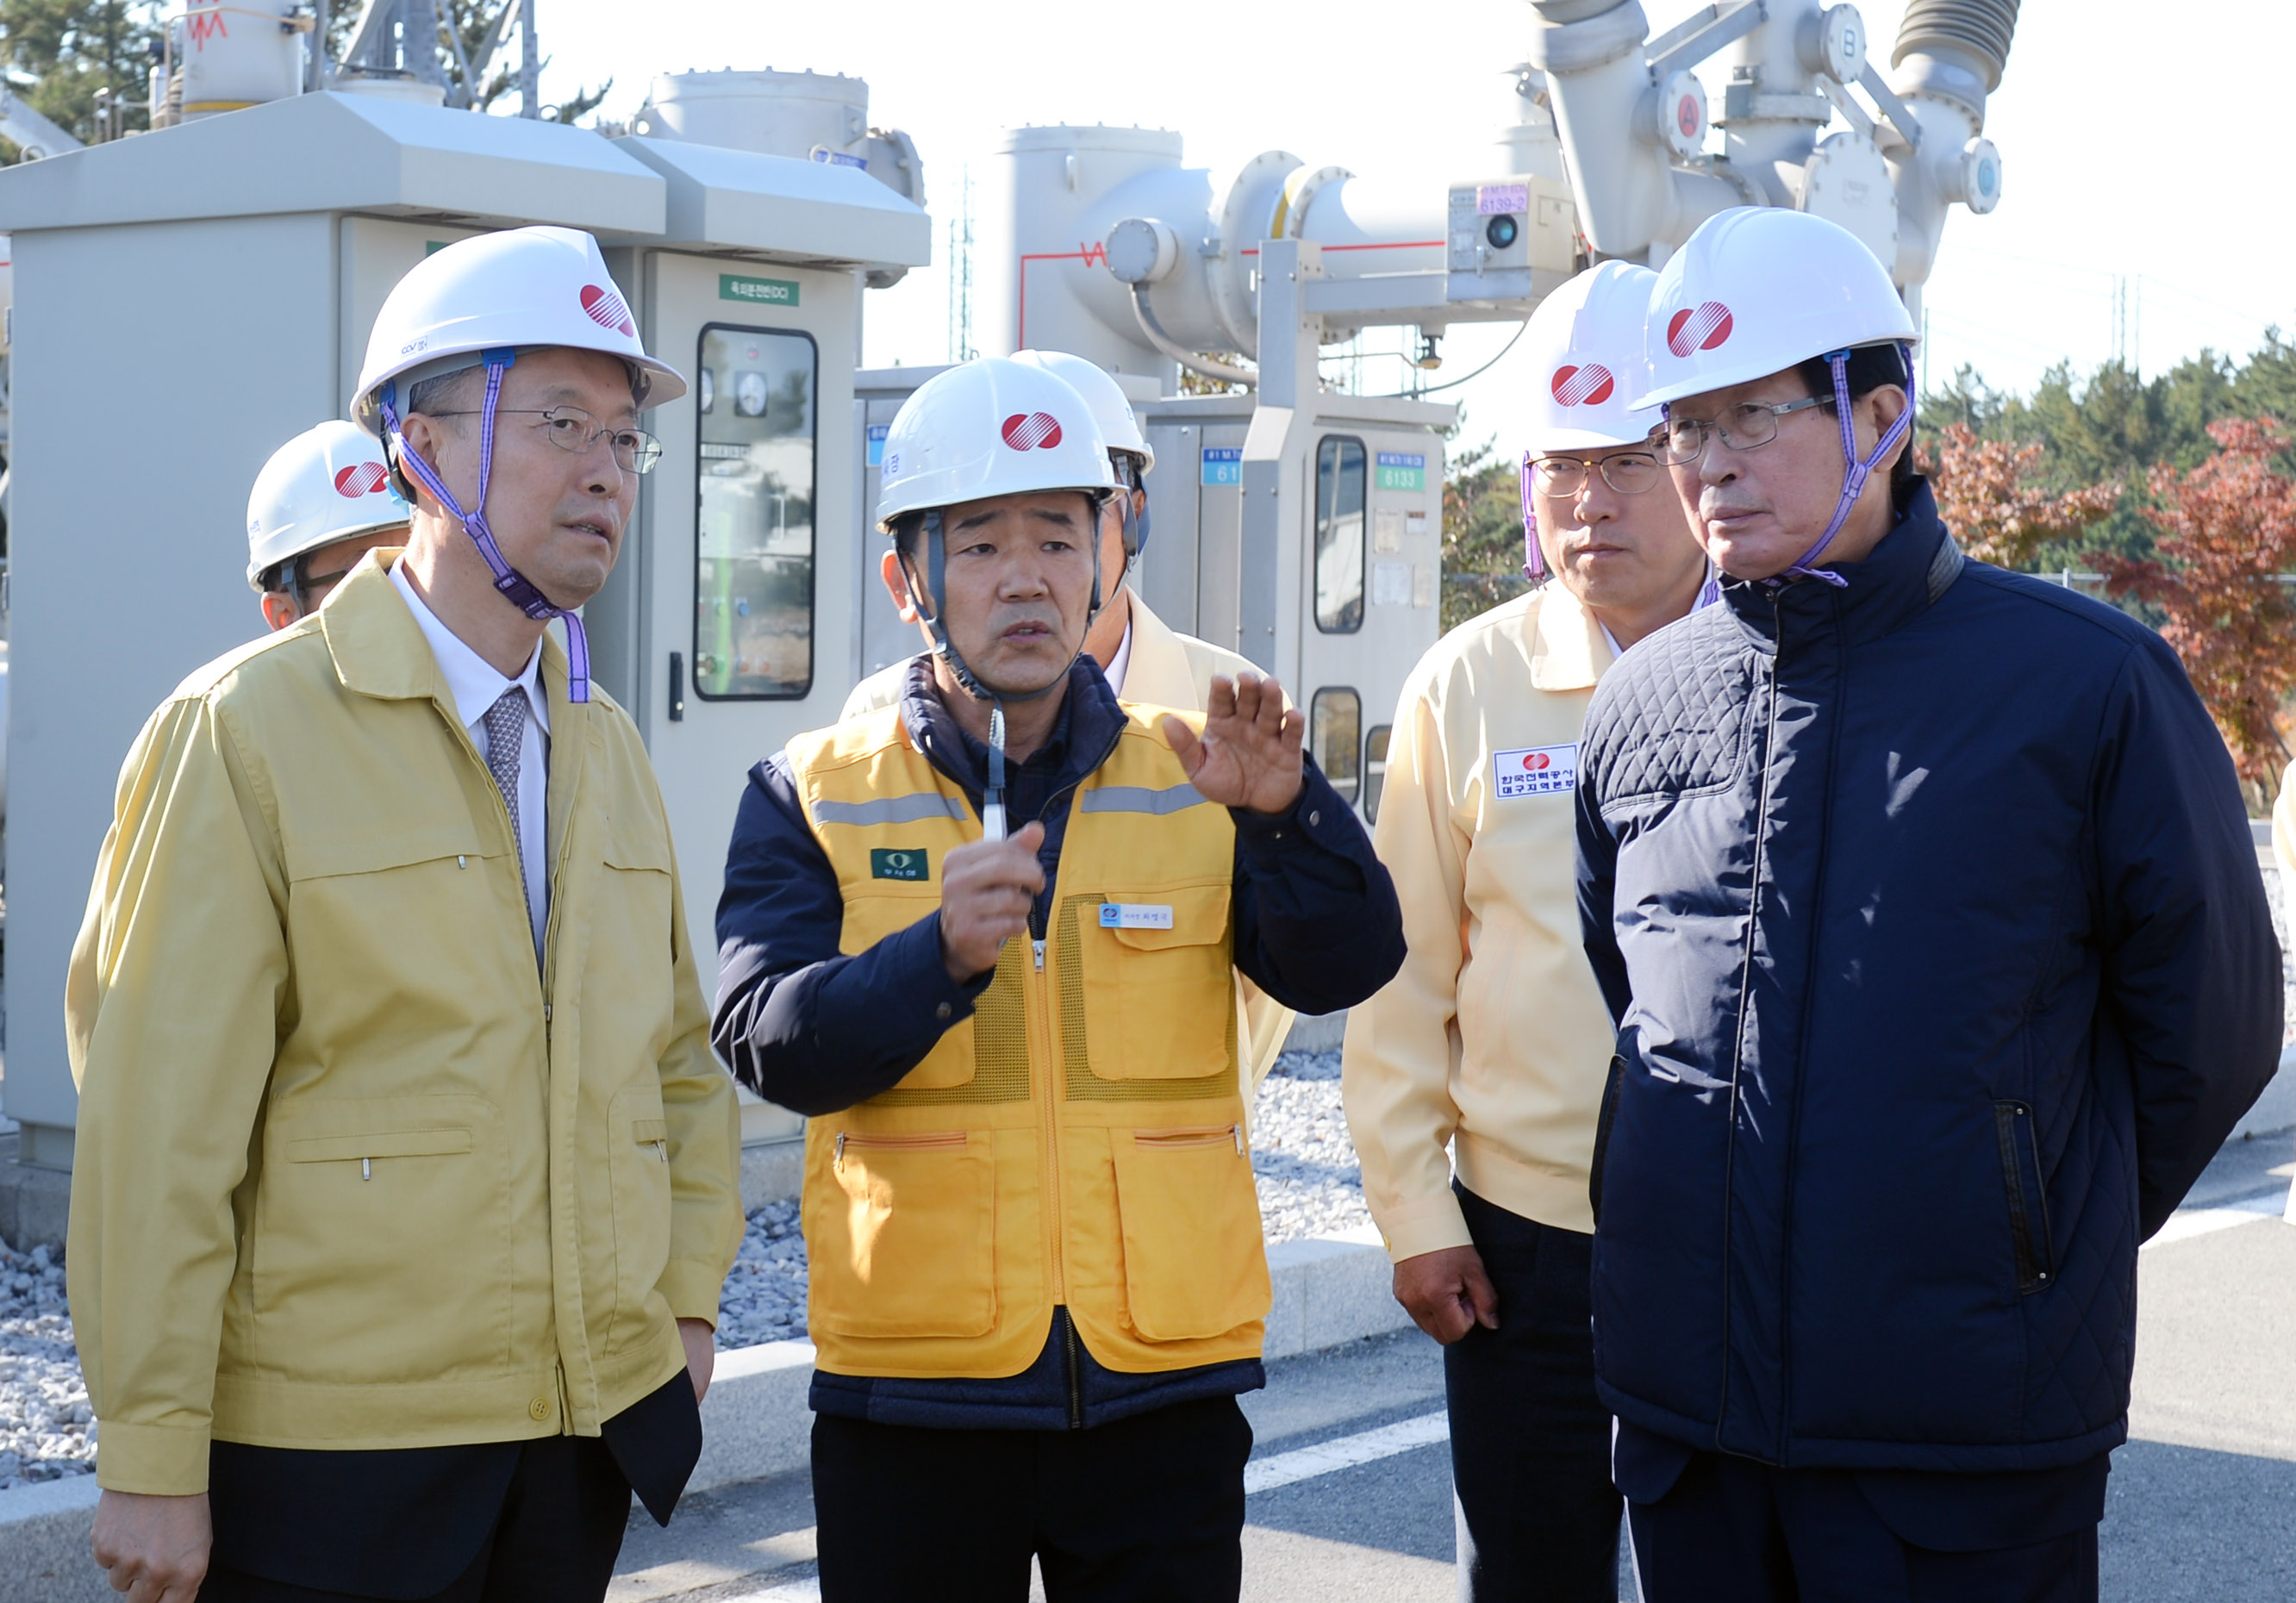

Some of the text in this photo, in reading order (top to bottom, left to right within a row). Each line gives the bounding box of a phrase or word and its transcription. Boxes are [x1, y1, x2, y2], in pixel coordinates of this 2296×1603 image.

[1844, 29, 1855, 58] B
[1681, 101, 1696, 130] A
[1481, 196, 1525, 213] 6139-2
[1385, 469, 1415, 488] 6133
[1501, 769, 1573, 785] 한국전력공사
[1502, 779, 1575, 794] 대구지역본부
